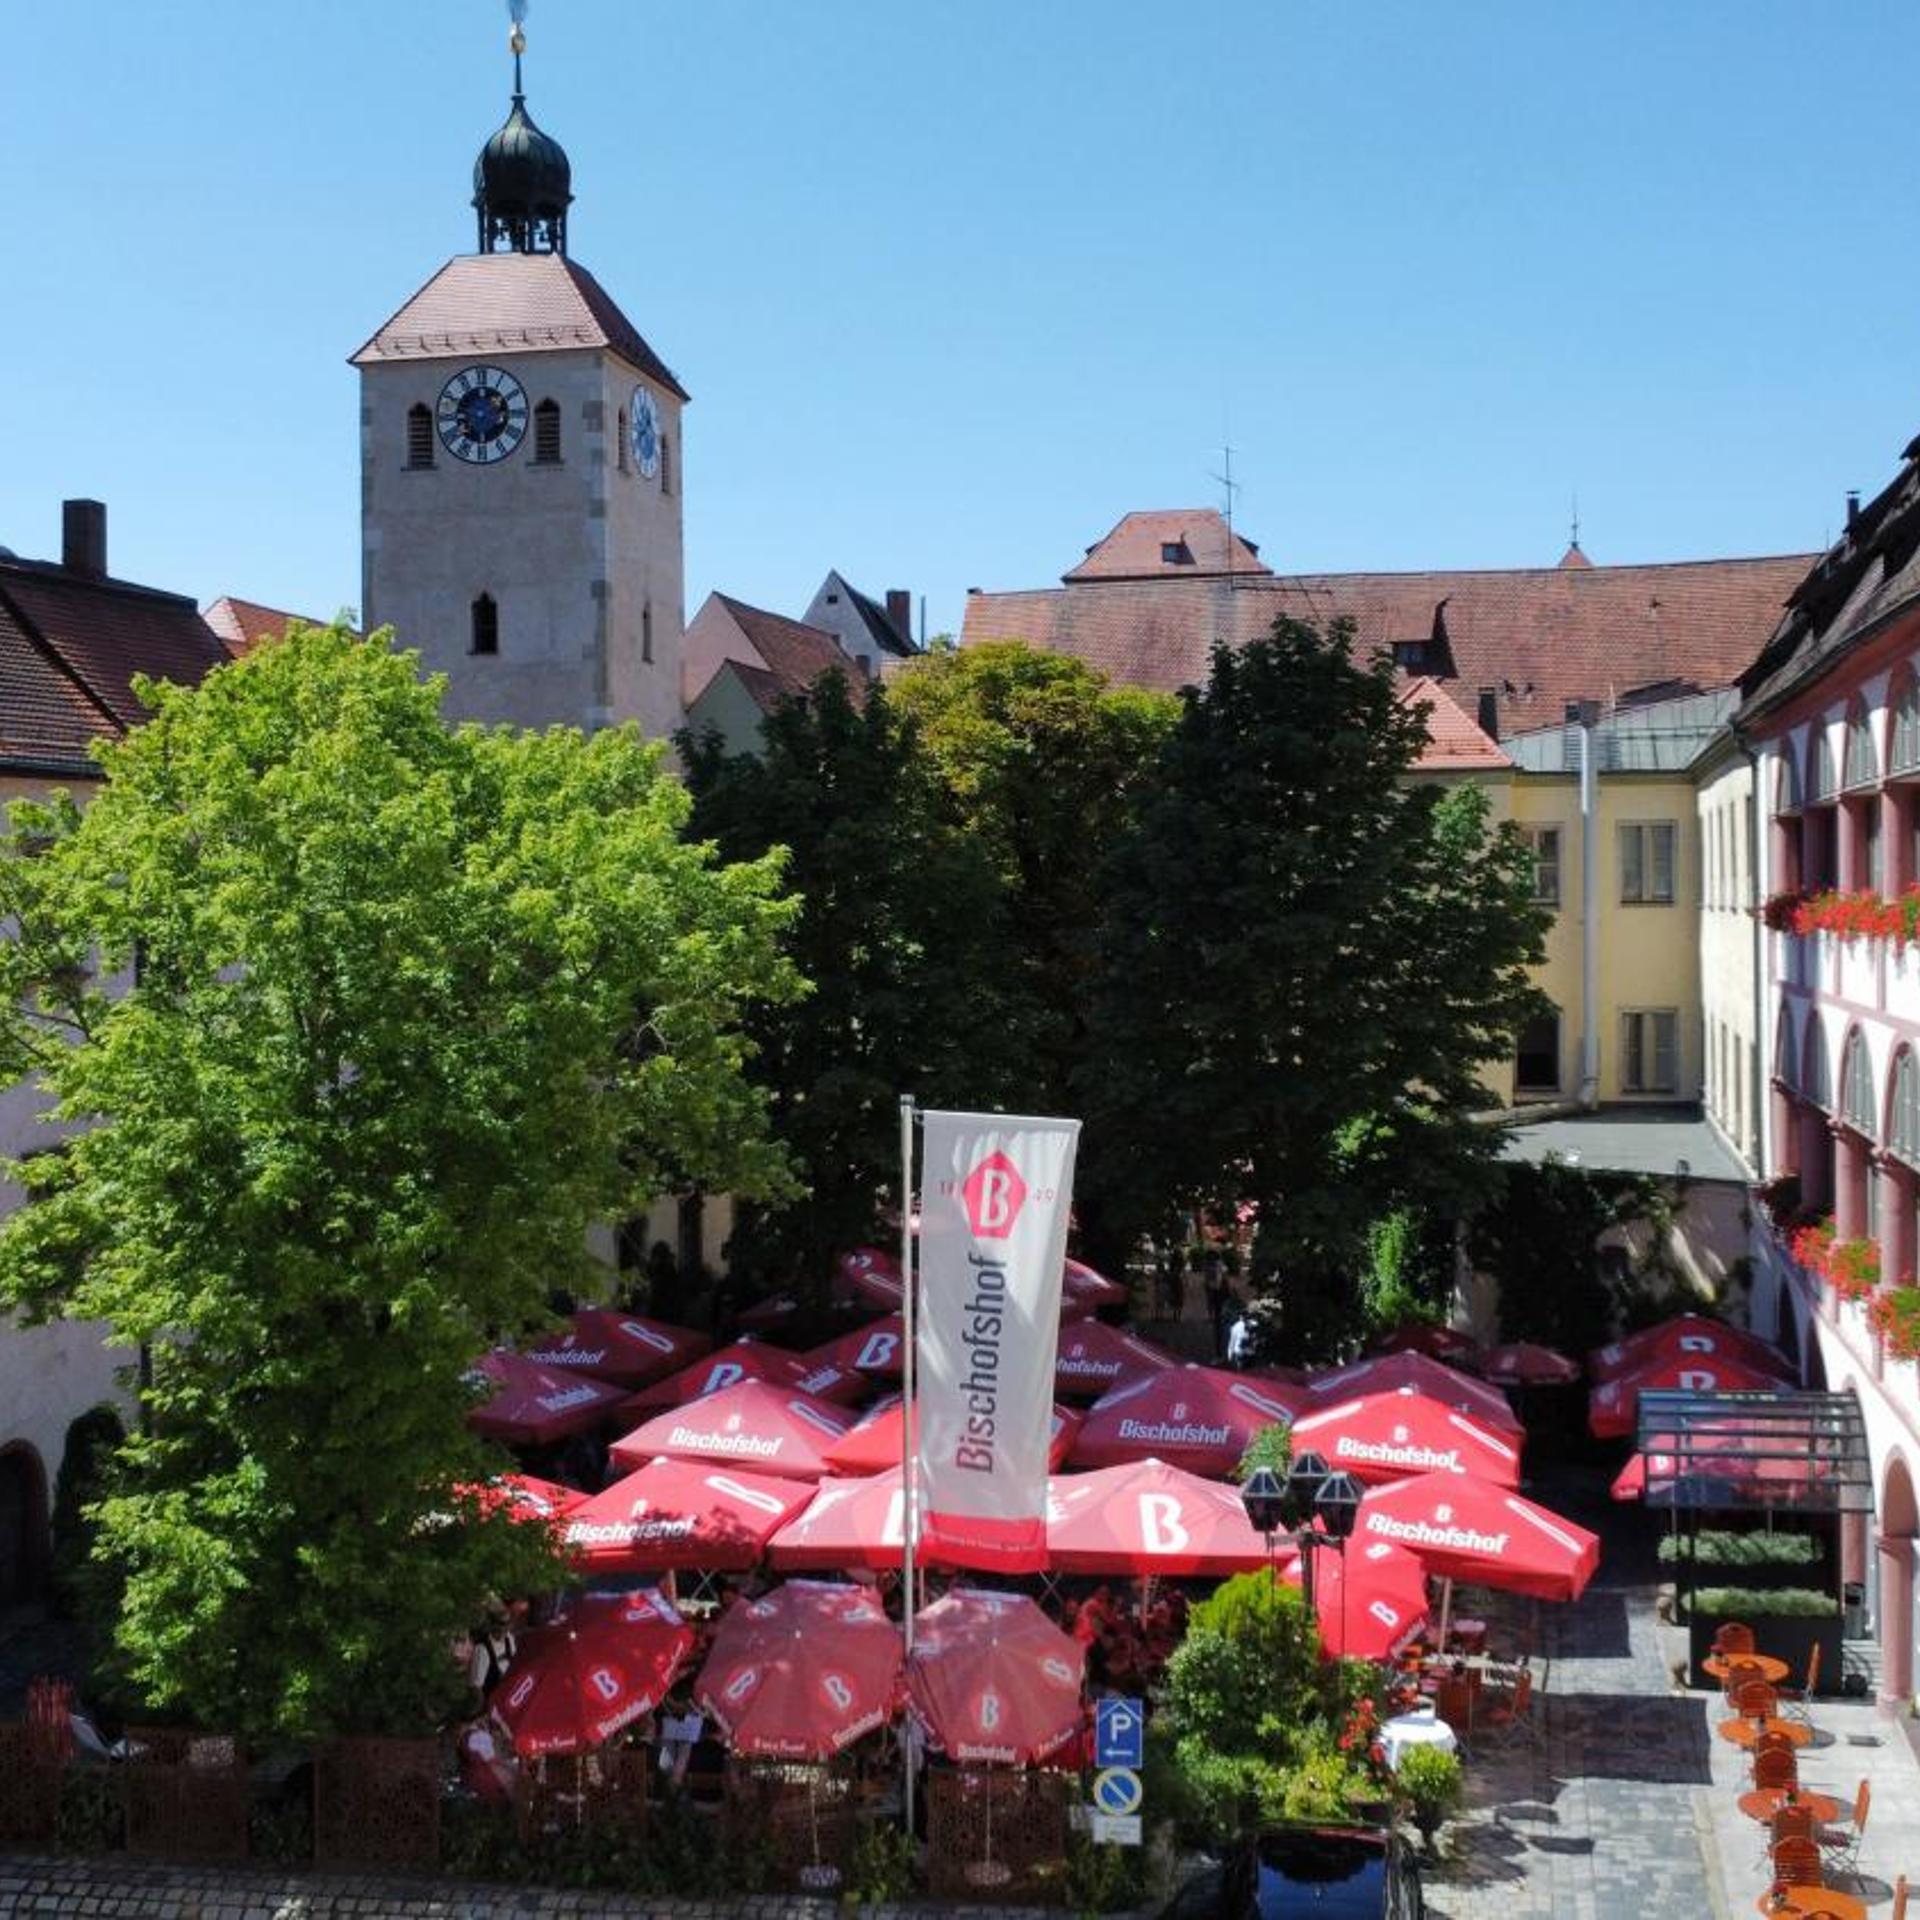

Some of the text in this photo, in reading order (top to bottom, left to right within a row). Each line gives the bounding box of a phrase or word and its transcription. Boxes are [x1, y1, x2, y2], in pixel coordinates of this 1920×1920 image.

[981, 1168, 1010, 1227] B
[956, 1252, 1008, 1474] Bischofshof
[667, 1427, 784, 1456] Bischofshof
[1118, 1418, 1230, 1445] Bischofshof
[1337, 1436, 1458, 1470] Bischofshof
[566, 1515, 698, 1544] Bischofshof
[1138, 1493, 1190, 1554] B
[1366, 1512, 1511, 1554] Bischofshof
[1111, 1713, 1131, 1742] P
